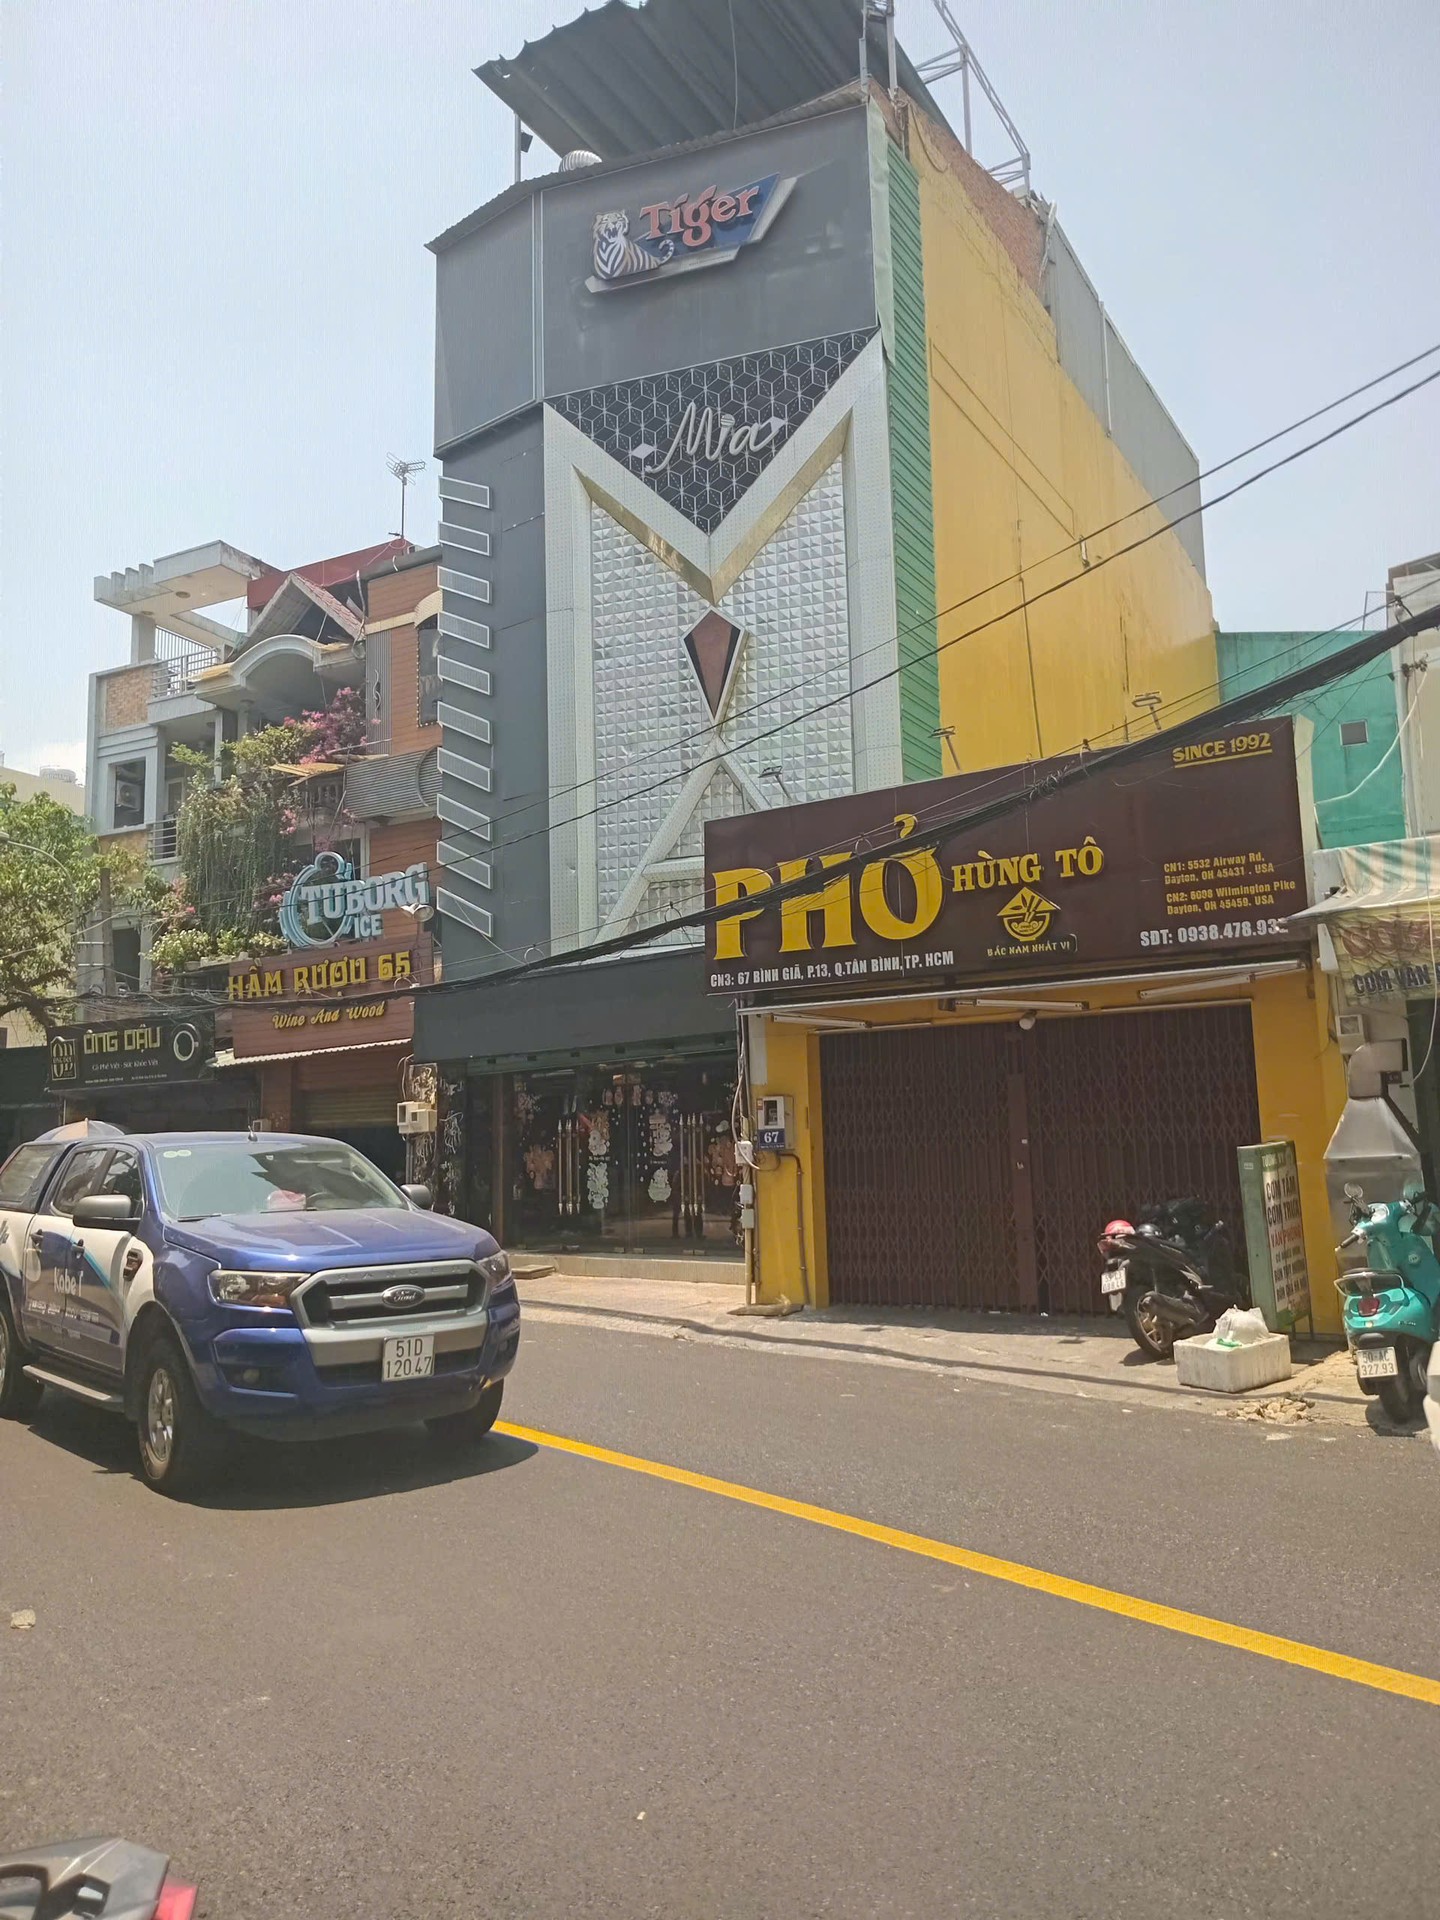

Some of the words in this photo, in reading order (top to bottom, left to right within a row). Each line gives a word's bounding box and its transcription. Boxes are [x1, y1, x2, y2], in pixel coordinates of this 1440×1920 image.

[639, 184, 760, 247] Tiger
[646, 402, 783, 473] Mia
[1172, 740, 1225, 762] SINCE
[1230, 732, 1272, 754] 1992
[952, 850, 1041, 893] HÙNG
[1055, 836, 1105, 876] TÔ
[1163, 862, 1186, 874] CN1:
[1187, 859, 1211, 871] 5532
[1213, 855, 1247, 868] Airway
[1201, 870, 1215, 880] OH
[1216, 867, 1246, 879] 45431
[1254, 862, 1275, 874] USA
[300, 862, 430, 924] TUBORG
[712, 813, 944, 960] PHỞ
[1166, 892, 1188, 904] CN2:
[1216, 883, 1271, 898] Wilmington
[1273, 880, 1297, 892] Pike
[1204, 900, 1218, 911] OH
[1254, 894, 1275, 906] USA
[354, 913, 383, 939] ICE
[1009, 945, 1030, 955] NAM
[378, 949, 412, 979] 65
[710, 973, 735, 988] CN3:
[738, 971, 751, 986] 67
[753, 968, 779, 984] BÌNH
[782, 964, 804, 981] GIÃ,
[807, 963, 831, 979] P.13,
[835, 958, 868, 978] Q.TÂN
[925, 950, 954, 967] HCM
[272, 1012, 305, 1030] Wine
[310, 1008, 340, 1025] And
[346, 1001, 386, 1019] Wood
[764, 1131, 779, 1143] 67
[393, 1290, 416, 1302] Ford
[396, 1338, 423, 1358] 51D
[386, 1356, 433, 1379] 120.47
